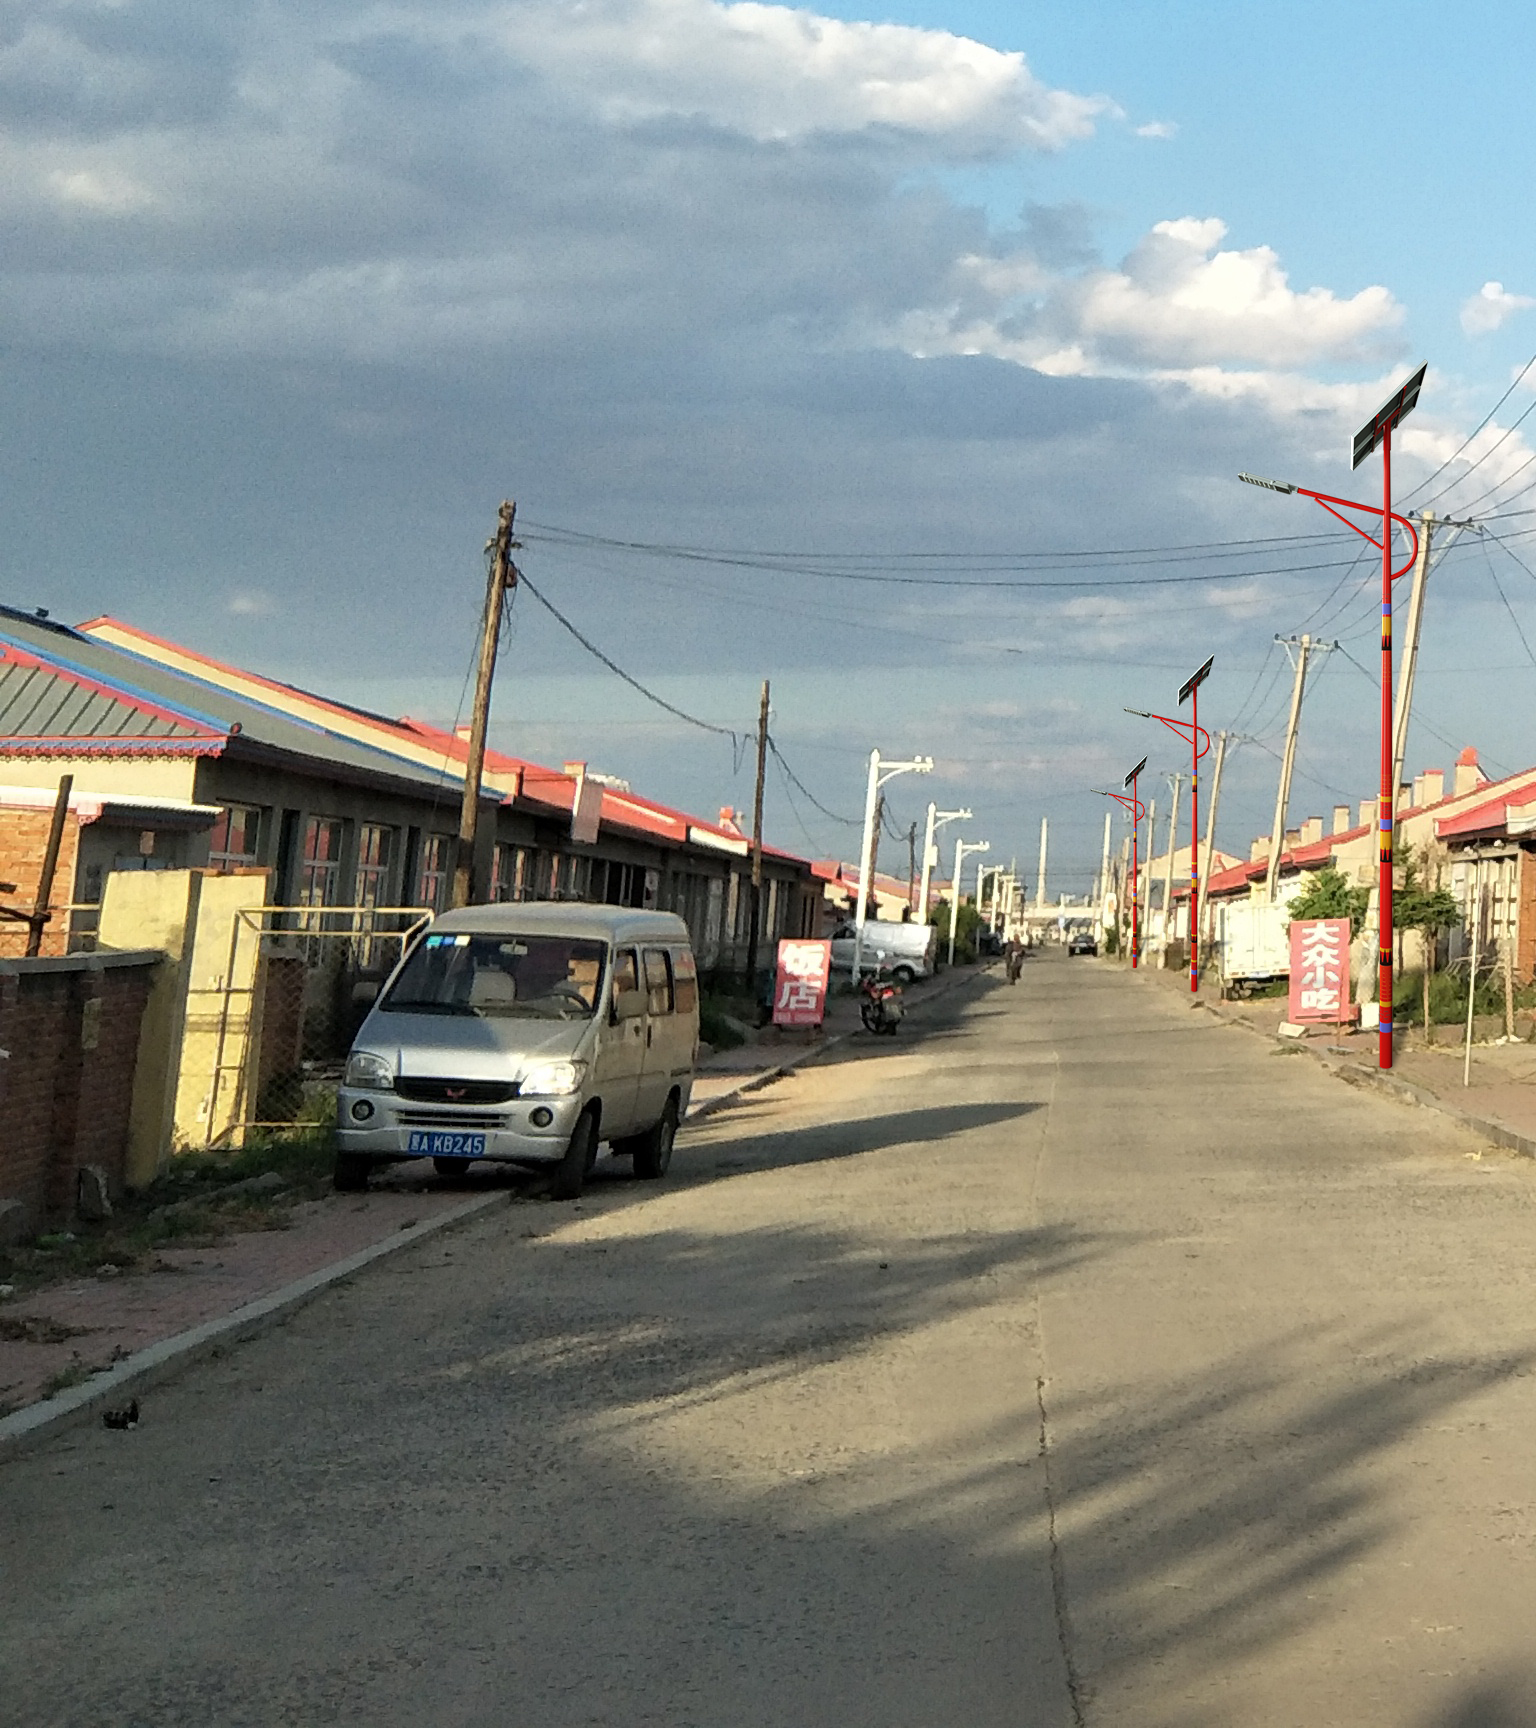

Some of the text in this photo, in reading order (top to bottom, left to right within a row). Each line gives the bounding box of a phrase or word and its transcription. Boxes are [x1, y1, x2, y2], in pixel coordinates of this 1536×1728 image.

[779, 943, 825, 1009] 饭店
[1301, 922, 1340, 1010] 大众小吃
